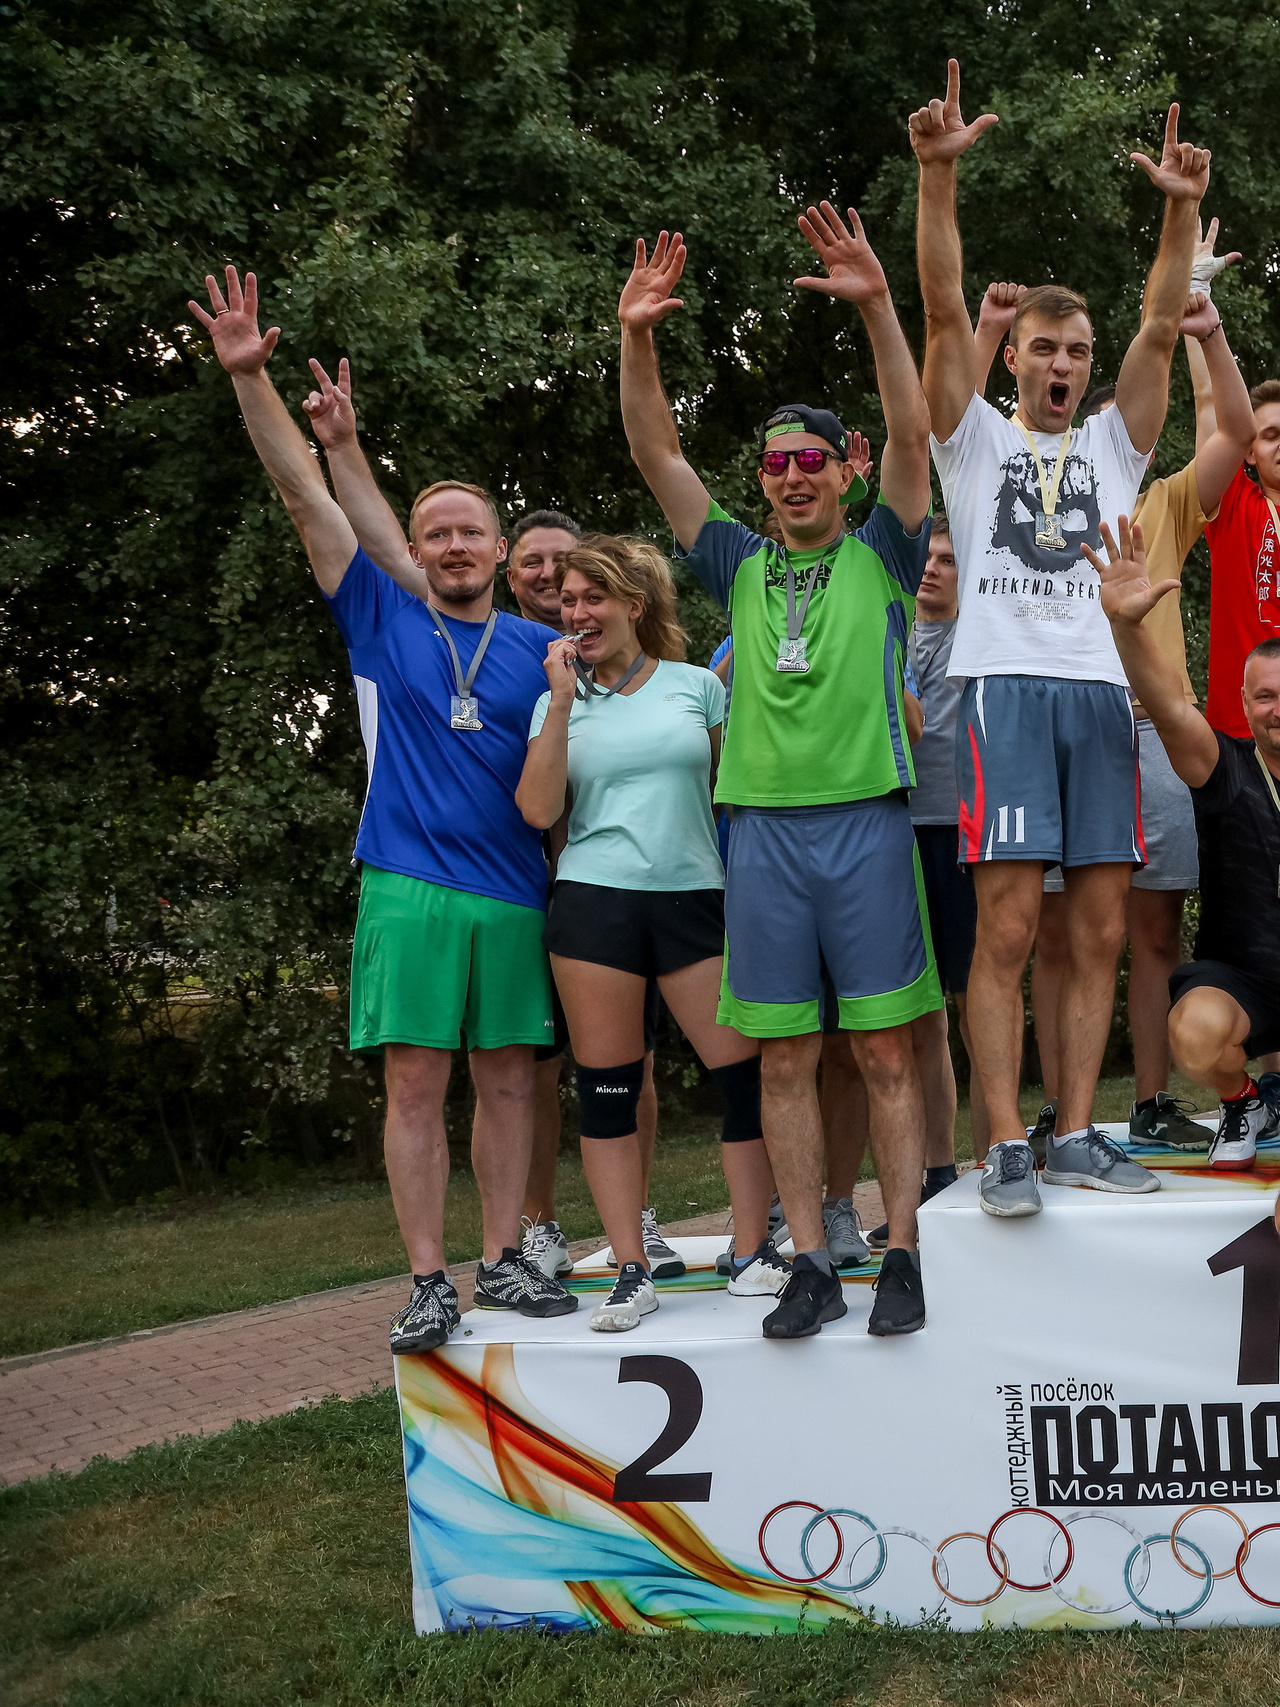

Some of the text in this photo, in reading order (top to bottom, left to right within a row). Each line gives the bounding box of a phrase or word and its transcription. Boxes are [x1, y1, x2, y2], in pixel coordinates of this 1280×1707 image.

[978, 577, 1053, 596] WEEKEND
[997, 805, 1025, 843] 11
[1030, 1377, 1115, 1402] посёлок
[613, 1354, 713, 1502] 2
[996, 1384, 1032, 1507] коттеджный
[1048, 1479, 1124, 1501] Моя
